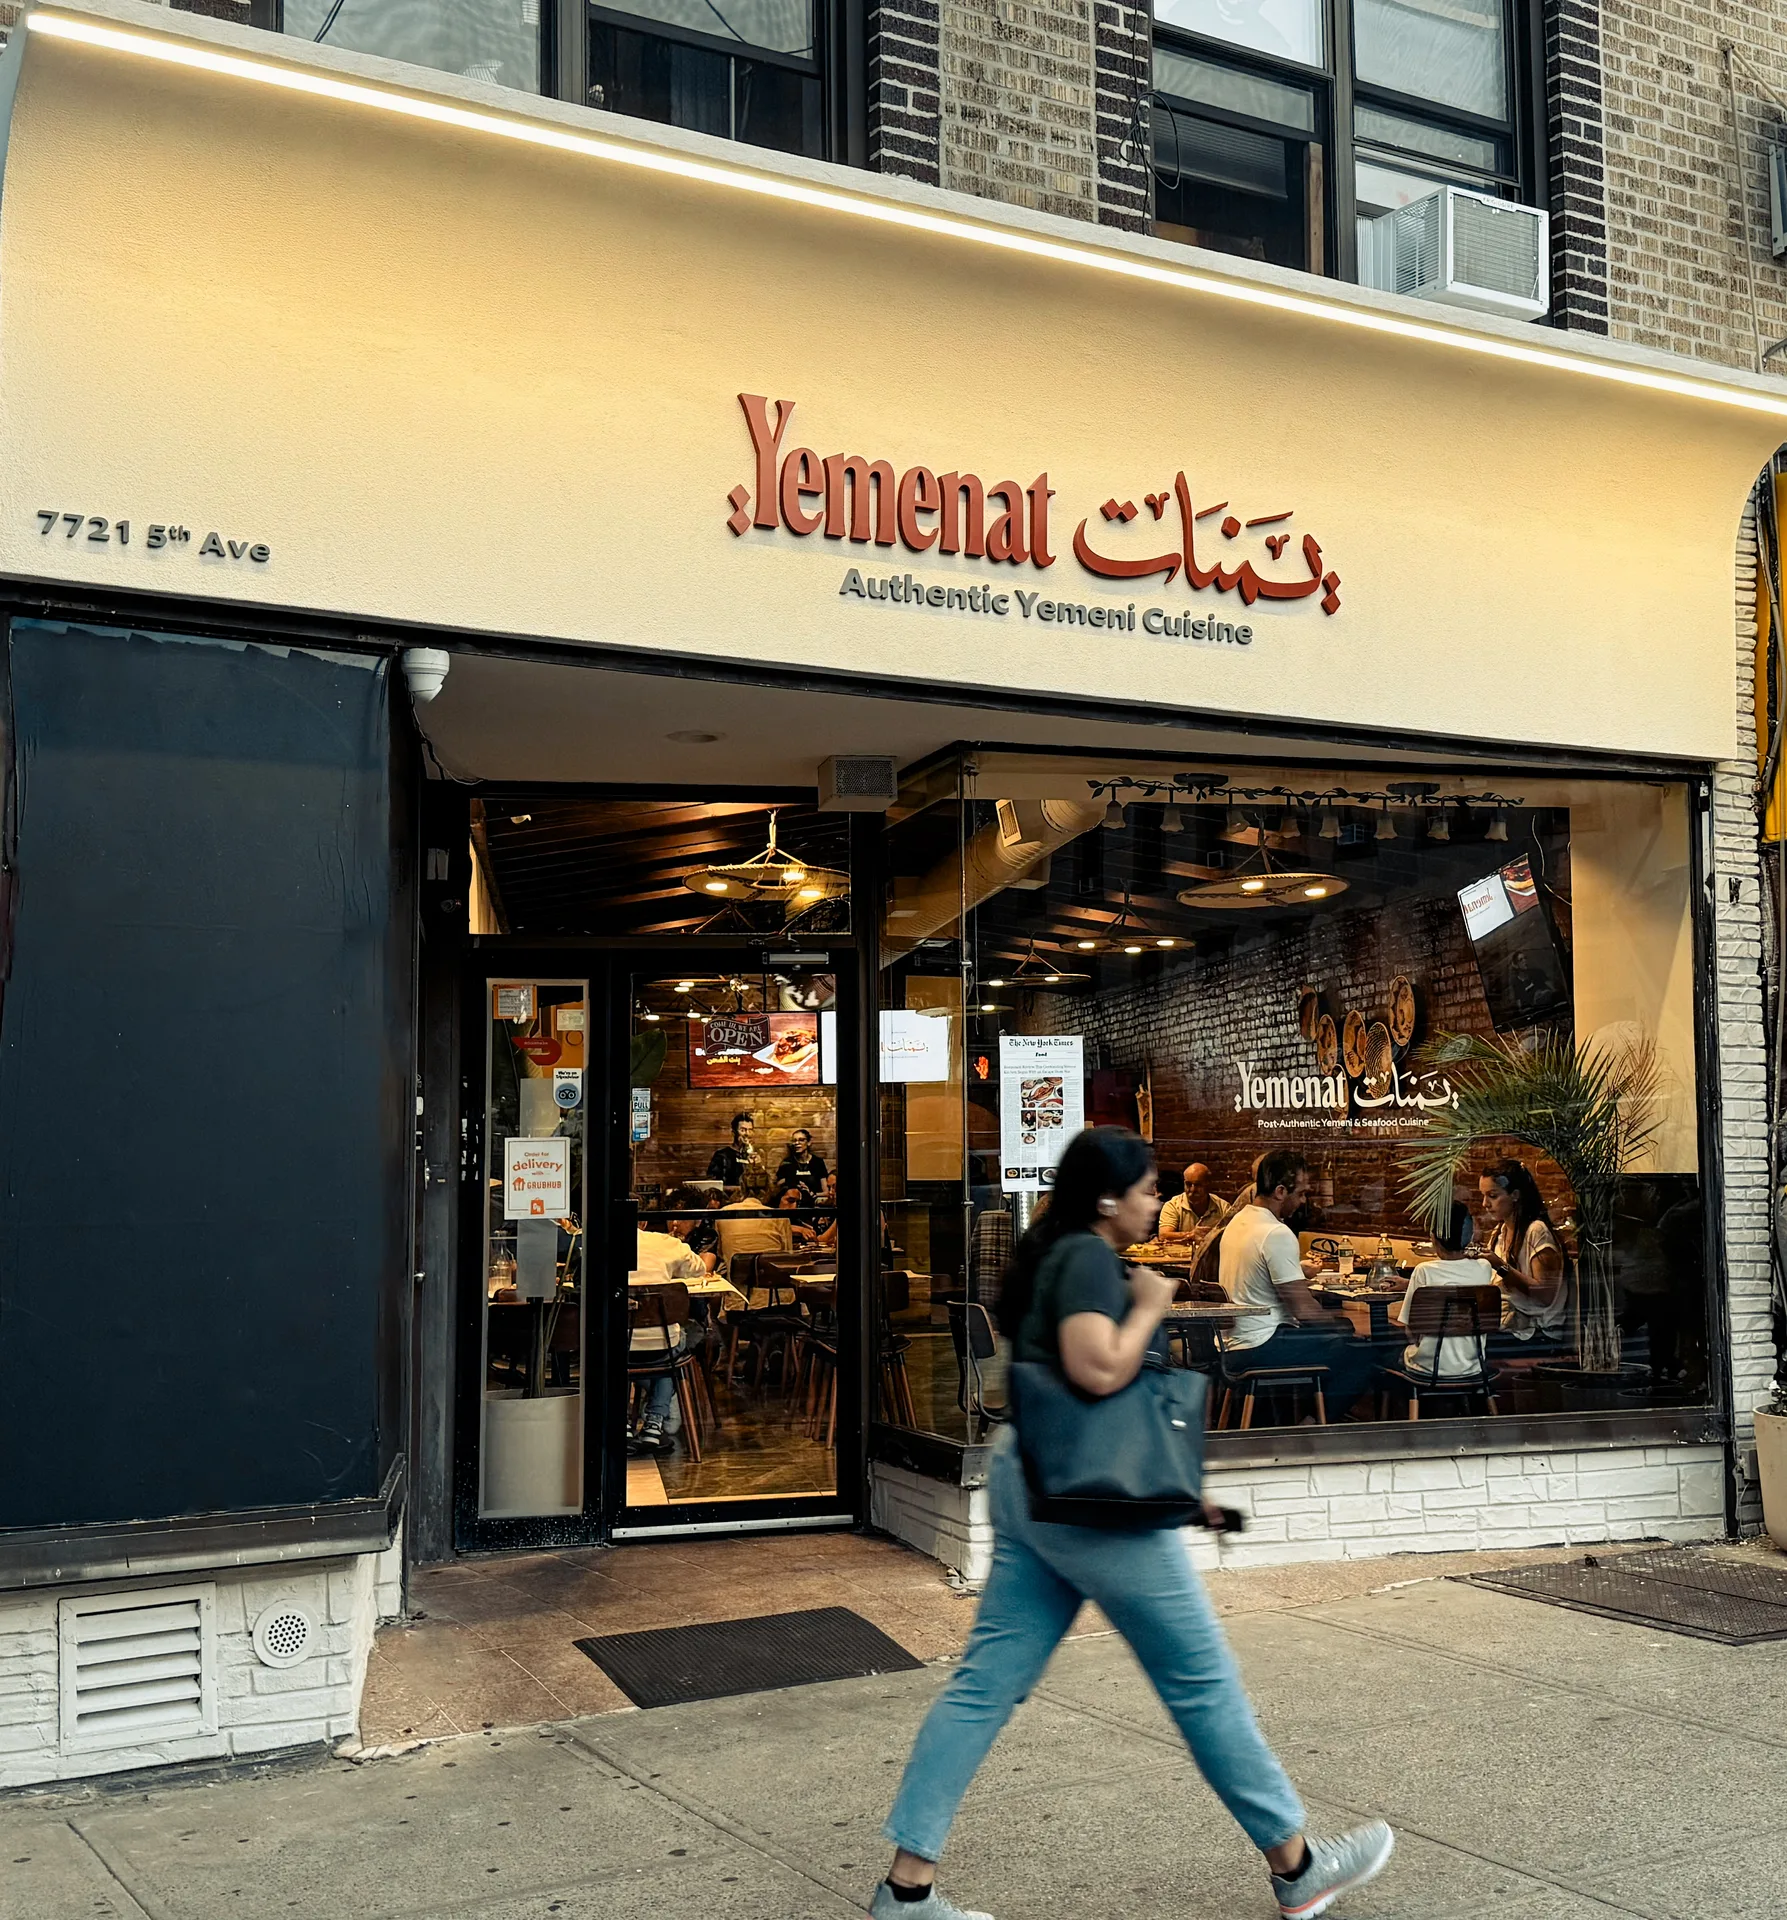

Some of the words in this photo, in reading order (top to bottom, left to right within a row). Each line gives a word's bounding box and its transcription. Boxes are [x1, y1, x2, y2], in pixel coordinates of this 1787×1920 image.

[728, 393, 1056, 569] Yemenat
[37, 510, 130, 544] 7721
[147, 524, 191, 548] 5th
[199, 531, 271, 562] Ave
[839, 568, 1009, 615] Authentic
[1014, 589, 1136, 632] Yemeni
[1143, 607, 1253, 645] Cuisine
[710, 1028, 763, 1047] OPEN
[1009, 1039, 1021, 1047] The
[1022, 1039, 1036, 1047] New
[1037, 1039, 1053, 1048] York
[1053, 1039, 1074, 1047] Times
[1234, 1061, 1348, 1112] Yemenat
[1257, 1118, 1321, 1128] Post-Authentic
[1321, 1118, 1353, 1128] Yemeni
[1354, 1118, 1362, 1127] &
[1362, 1117, 1398, 1127] Seafood
[1398, 1117, 1430, 1127] Cuisine
[512, 1158, 563, 1172] delivery
[526, 1180, 562, 1189] GRUBHUB
